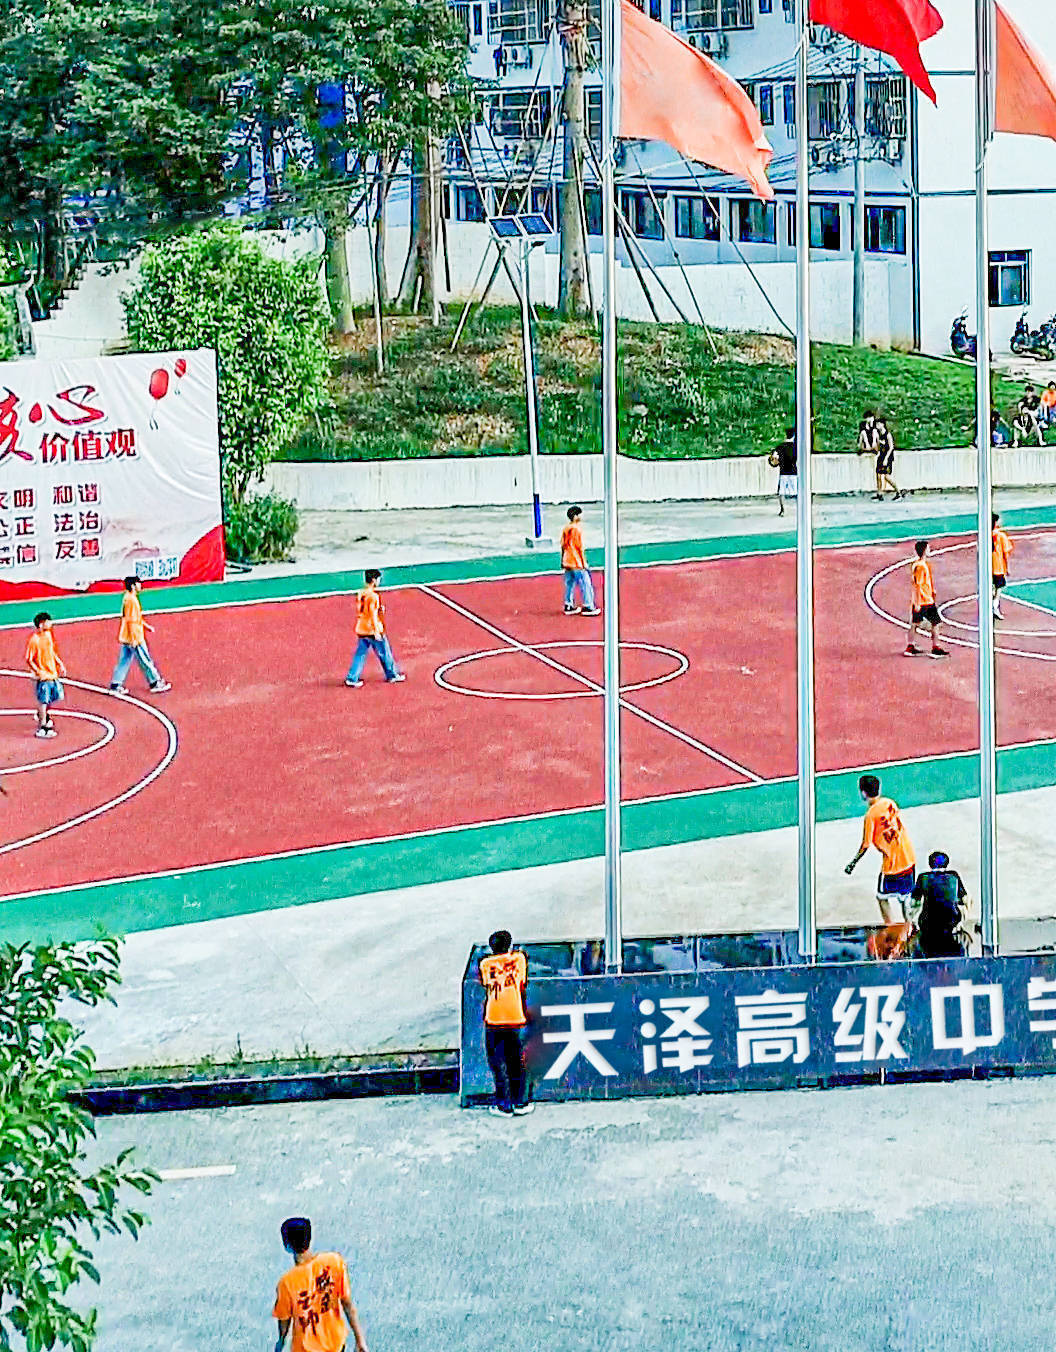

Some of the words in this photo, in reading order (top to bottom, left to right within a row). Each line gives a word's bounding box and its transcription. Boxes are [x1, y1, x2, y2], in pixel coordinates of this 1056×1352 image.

[39, 429, 136, 463] 价值观
[53, 483, 98, 504] 和谐
[54, 510, 99, 532] 法治
